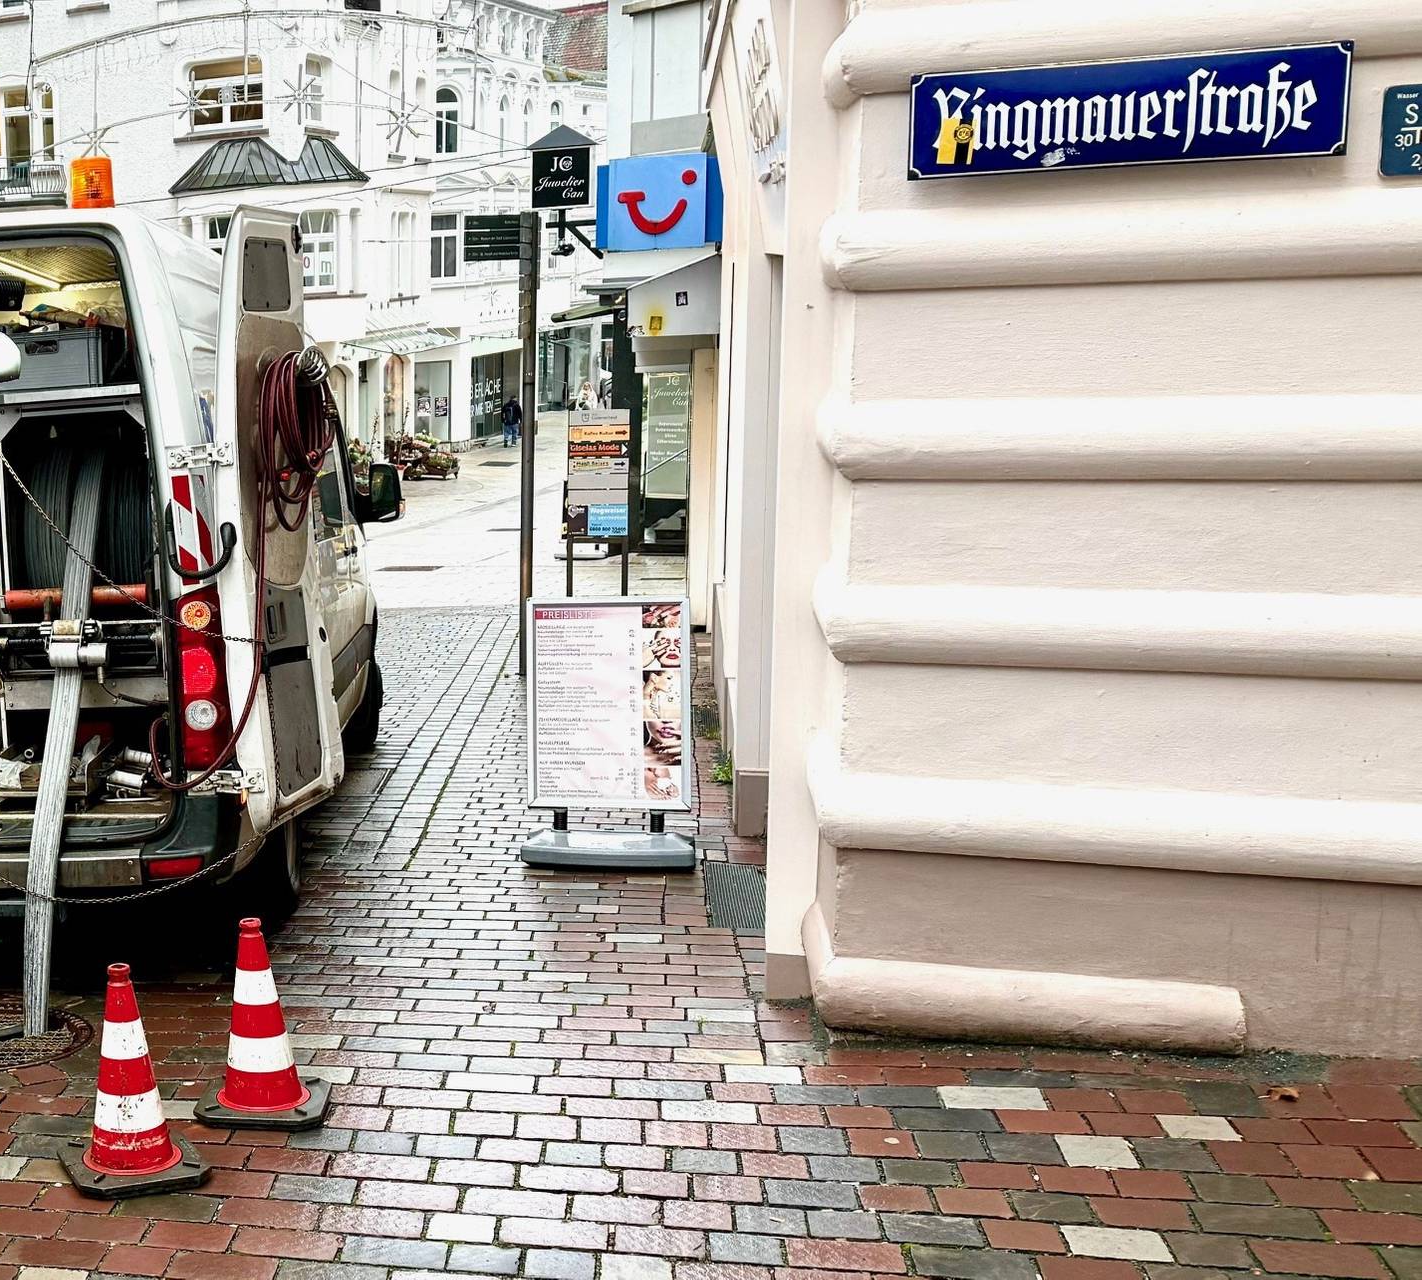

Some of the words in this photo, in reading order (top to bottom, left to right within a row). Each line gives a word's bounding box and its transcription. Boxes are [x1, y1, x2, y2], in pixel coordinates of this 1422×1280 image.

[550, 155, 574, 172] JC
[534, 175, 585, 192] Juwelier
[562, 187, 584, 199] Can
[542, 610, 595, 619] PREISLISTE
